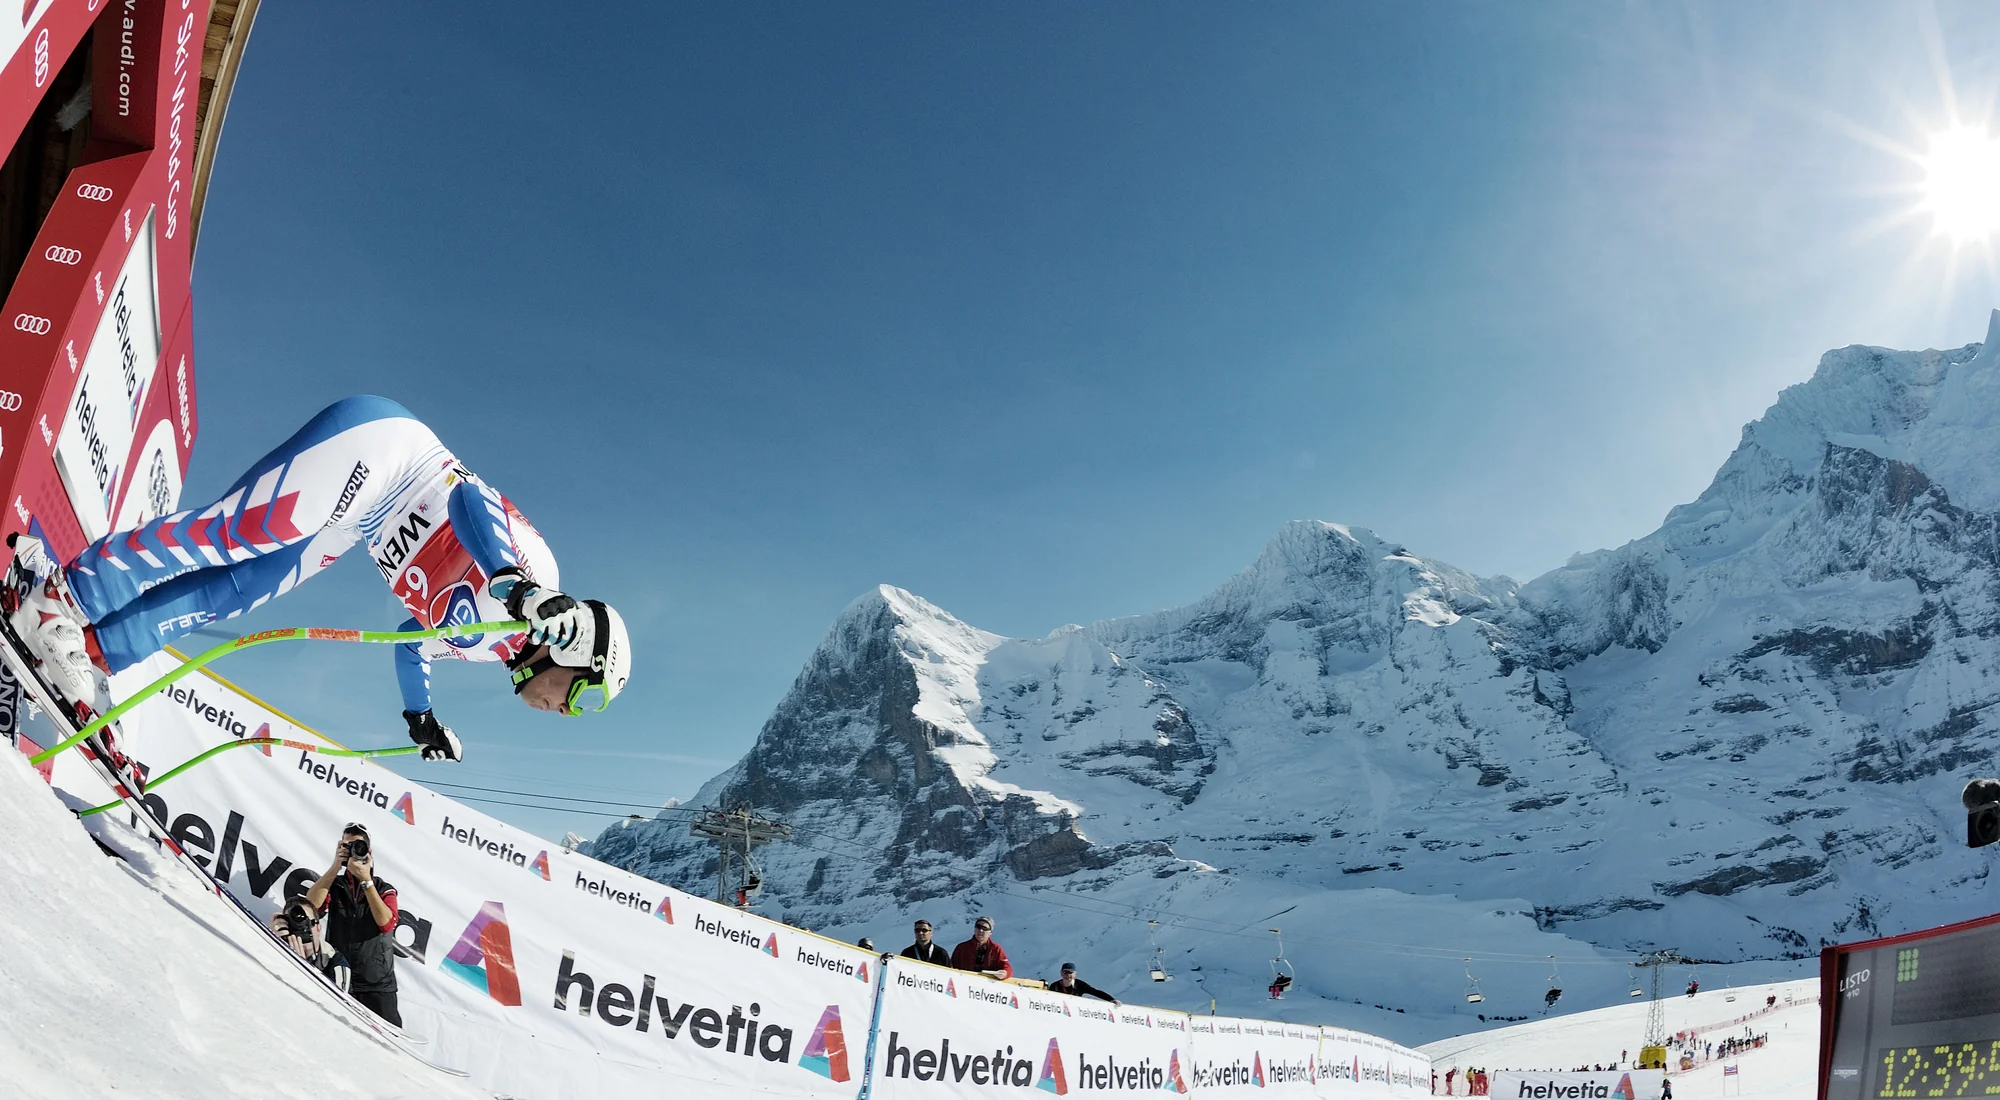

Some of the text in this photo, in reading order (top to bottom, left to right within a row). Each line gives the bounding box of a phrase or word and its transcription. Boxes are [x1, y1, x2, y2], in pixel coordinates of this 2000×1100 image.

[168, 70, 187, 182] World
[95, 271, 104, 305] Audi
[113, 274, 138, 400] helvetia
[66, 340, 78, 373] Audi
[39, 413, 53, 446] Audi
[75, 372, 109, 493] helvetia
[14, 494, 30, 526] Audi
[298, 751, 389, 811] helvetia
[441, 816, 527, 869] helvetia
[575, 870, 652, 914] helvetia
[695, 914, 761, 949] helvetia
[797, 946, 854, 977] helvetia
[897, 971, 944, 994] helvetia
[968, 986, 1008, 1006] helvetia
[1839, 968, 1871, 993] LISTO
[554, 948, 793, 1064] helvetia
[1028, 998, 1062, 1015] helvetia
[1078, 1006, 1108, 1022] helvetia
[1121, 1013, 1146, 1027] helvetia
[1157, 1018, 1180, 1031] helvetia
[885, 1031, 1033, 1087] helvetia
[1079, 1053, 1163, 1090] helvetia
[1193, 1057, 1249, 1089] helvetia
[1269, 1058, 1308, 1084] helvetia
[1317, 1059, 1351, 1080] helvetia
[1362, 1062, 1385, 1081] helvetia
[1518, 1077, 1609, 1100] helvetia
